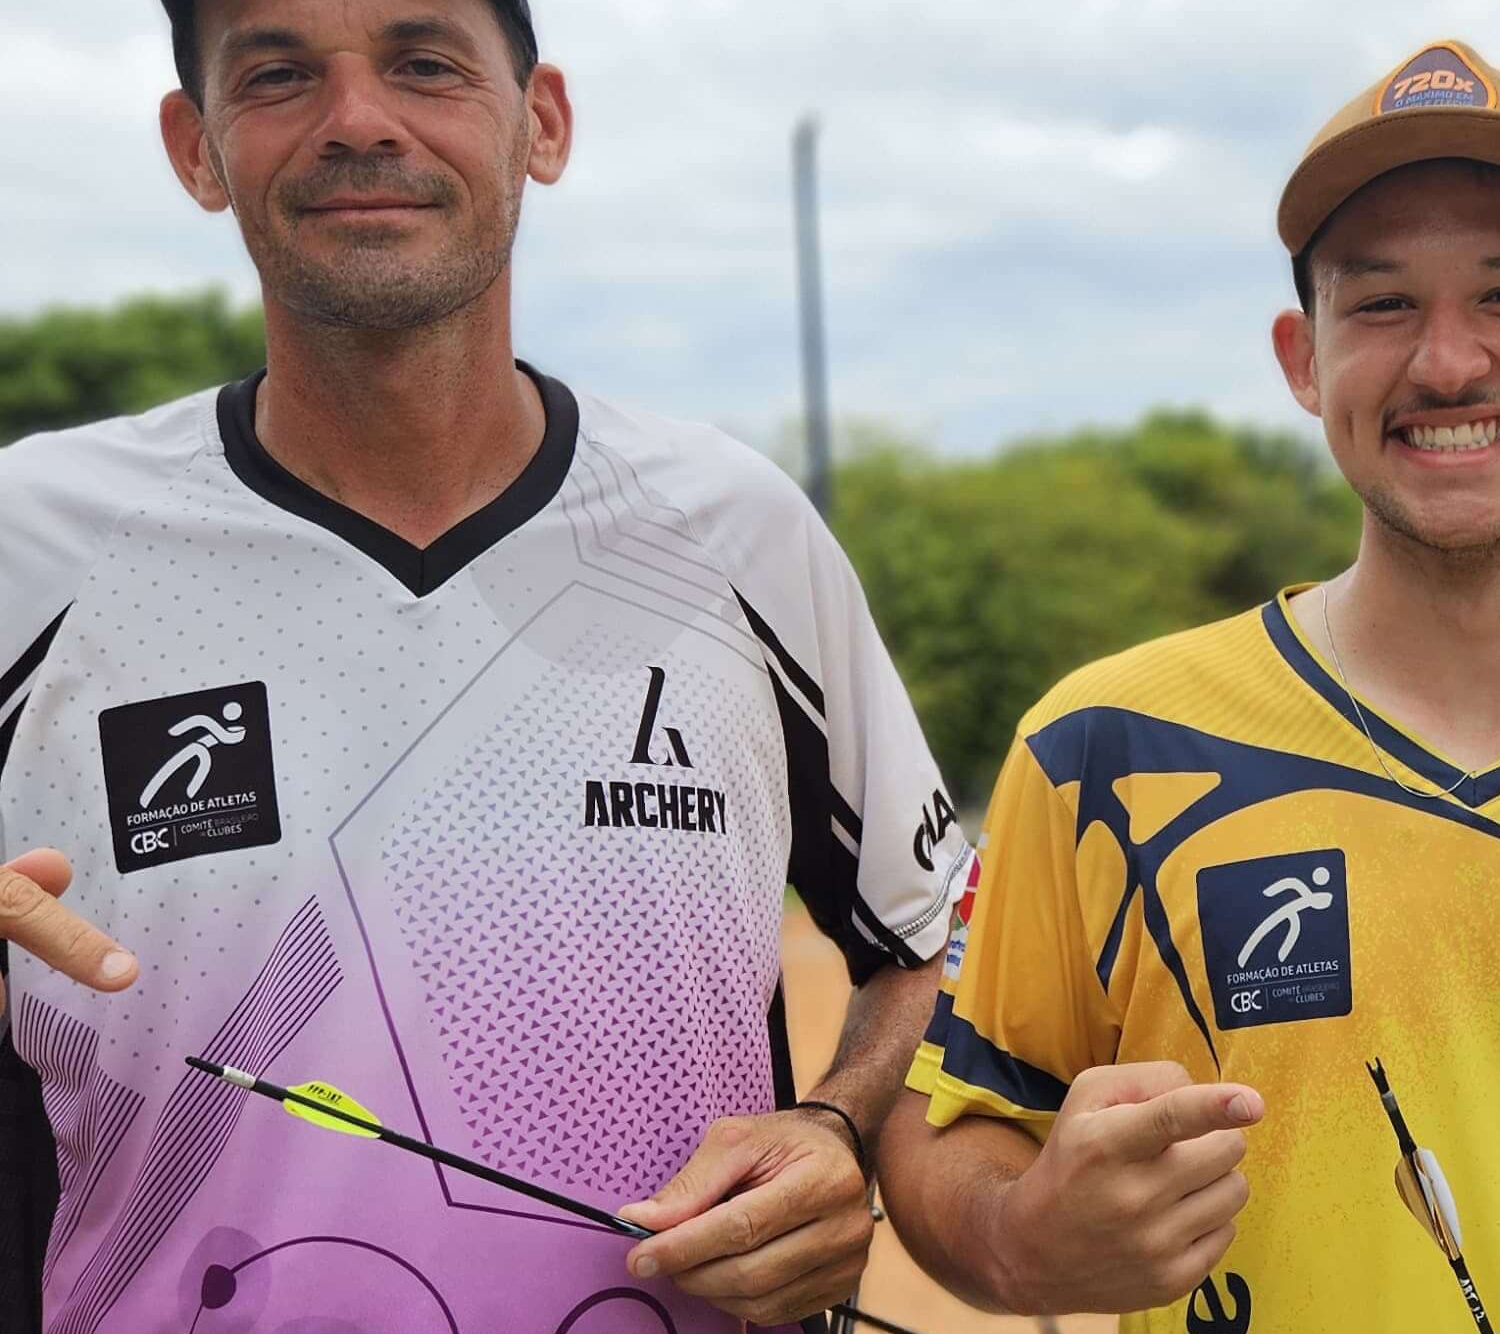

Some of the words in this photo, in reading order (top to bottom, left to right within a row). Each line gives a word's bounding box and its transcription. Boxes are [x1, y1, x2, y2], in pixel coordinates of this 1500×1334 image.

[190, 800, 206, 813] DE
[207, 791, 257, 809] ATLETAS
[584, 780, 727, 835] ARCHERY
[131, 827, 169, 854] CBC
[207, 824, 242, 837] CLUBES
[1281, 965, 1294, 977] DE
[1295, 960, 1339, 974] ATLETAS
[1231, 989, 1262, 1013] CBC
